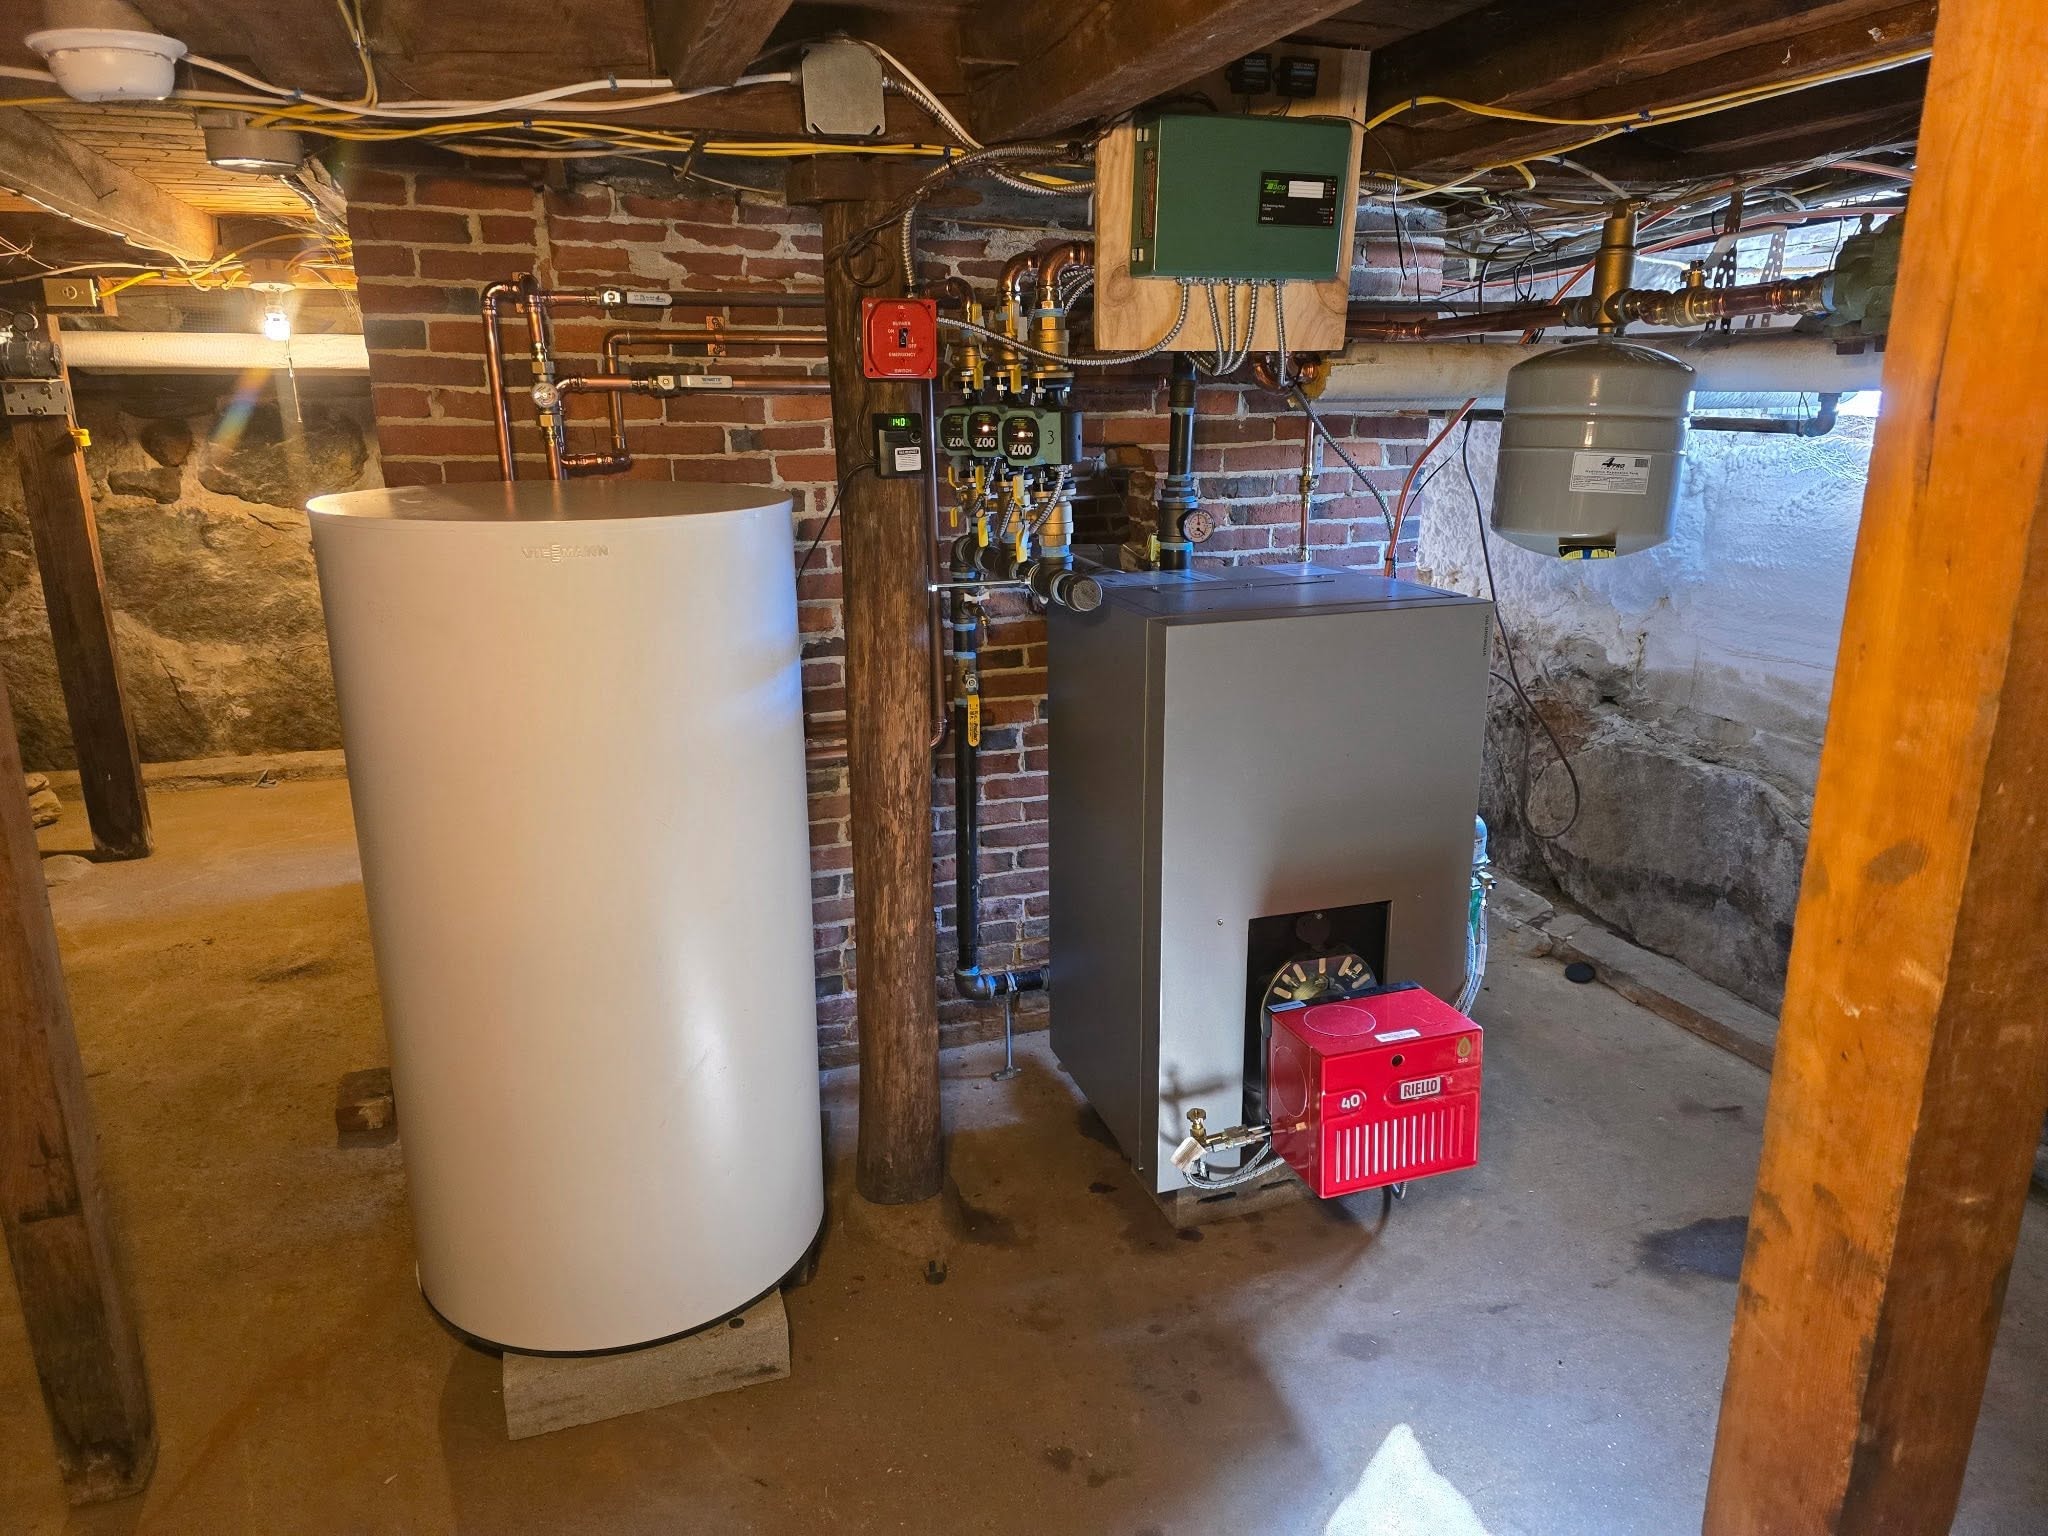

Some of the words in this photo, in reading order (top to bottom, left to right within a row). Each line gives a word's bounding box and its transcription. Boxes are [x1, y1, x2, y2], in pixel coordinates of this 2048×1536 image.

[892, 417, 906, 427] 140
[1403, 1079, 1438, 1097] RIELLO
[1341, 1094, 1361, 1109] 40
